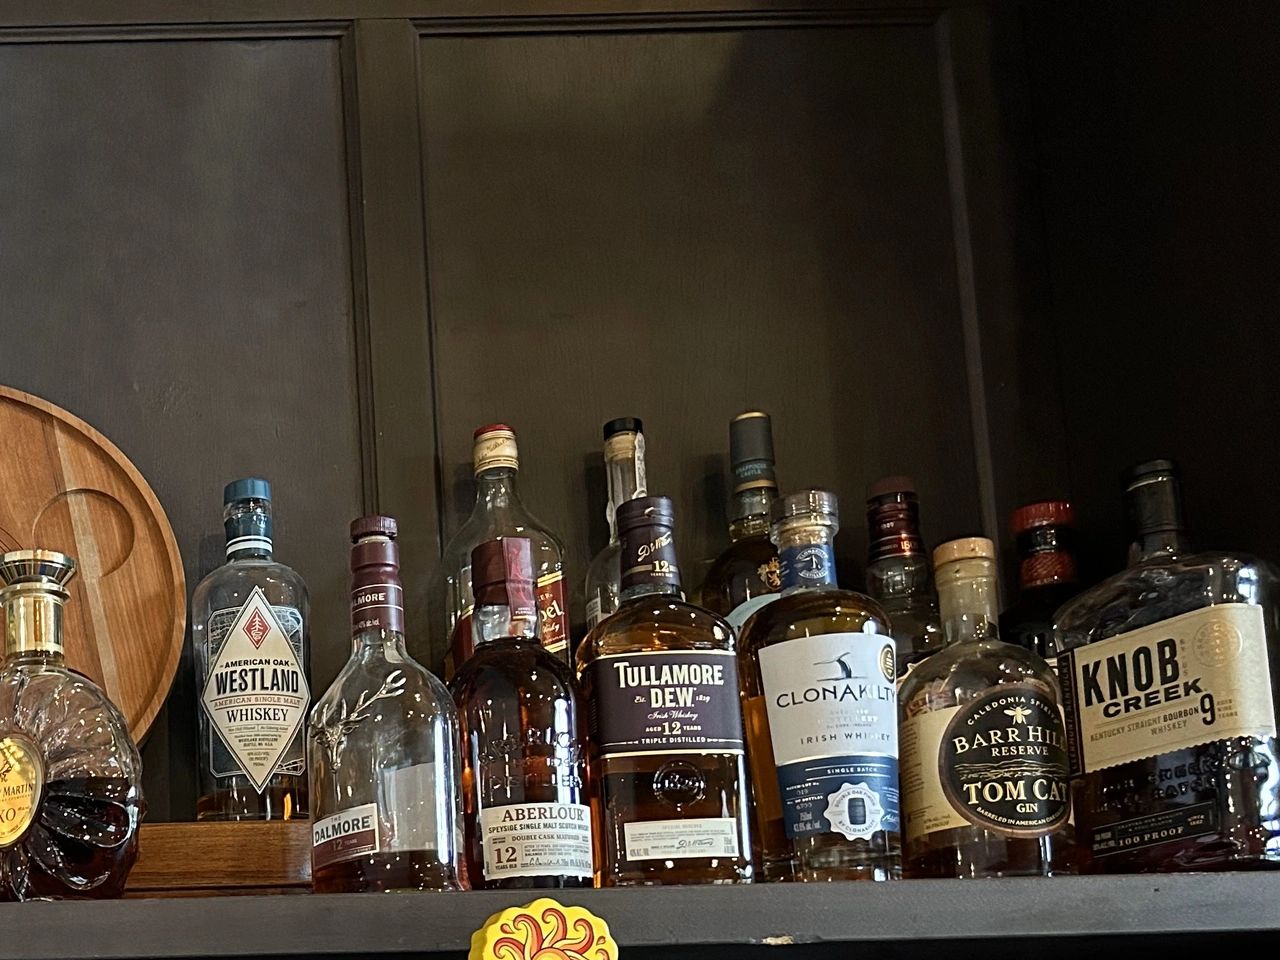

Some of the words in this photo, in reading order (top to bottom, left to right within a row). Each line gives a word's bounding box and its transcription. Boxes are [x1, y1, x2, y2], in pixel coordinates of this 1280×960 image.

[653, 560, 669, 572] 12
[225, 659, 271, 669] AMERICAN
[273, 659, 290, 667] OAK
[1082, 638, 1180, 707] KNOB
[215, 668, 299, 695] WESTLAND
[613, 662, 724, 688] TULLAMORE
[214, 697, 252, 708] AMERICAN
[283, 698, 301, 706] MALT
[650, 687, 695, 708] D.E.W.
[1103, 677, 1203, 718] CREEK
[226, 707, 289, 723] WHISKEY
[647, 710, 669, 720] Irish
[669, 710, 698, 721] Whiskey
[967, 696, 1026, 726] CALEDONIA
[1200, 693, 1216, 726] 9
[662, 721, 682, 735] 12
[1127, 716, 1161, 733] STRAIGHT
[1163, 706, 1199, 723] BOURBON
[1150, 720, 1187, 736] WHISKEY
[800, 734, 837, 745] IRISH
[952, 727, 1020, 754] BARR
[991, 745, 1049, 757] RESERVE
[963, 780, 1027, 805] TOM
[1032, 779, 1067, 802] CAT
[502, 807, 584, 823] ABERLOUR
[976, 807, 1007, 824] BARRELED
[1015, 818, 1047, 826] AMERICAN
[1016, 803, 1039, 813] GIN
[314, 817, 371, 844] DALMORE
[488, 824, 518, 834] SPEYSIDE
[519, 822, 541, 831] SINGLE
[1119, 835, 1141, 847] 100
[1144, 826, 1185, 842] PROOF
[512, 834, 537, 842] DOUBLE
[494, 846, 518, 864] 12
